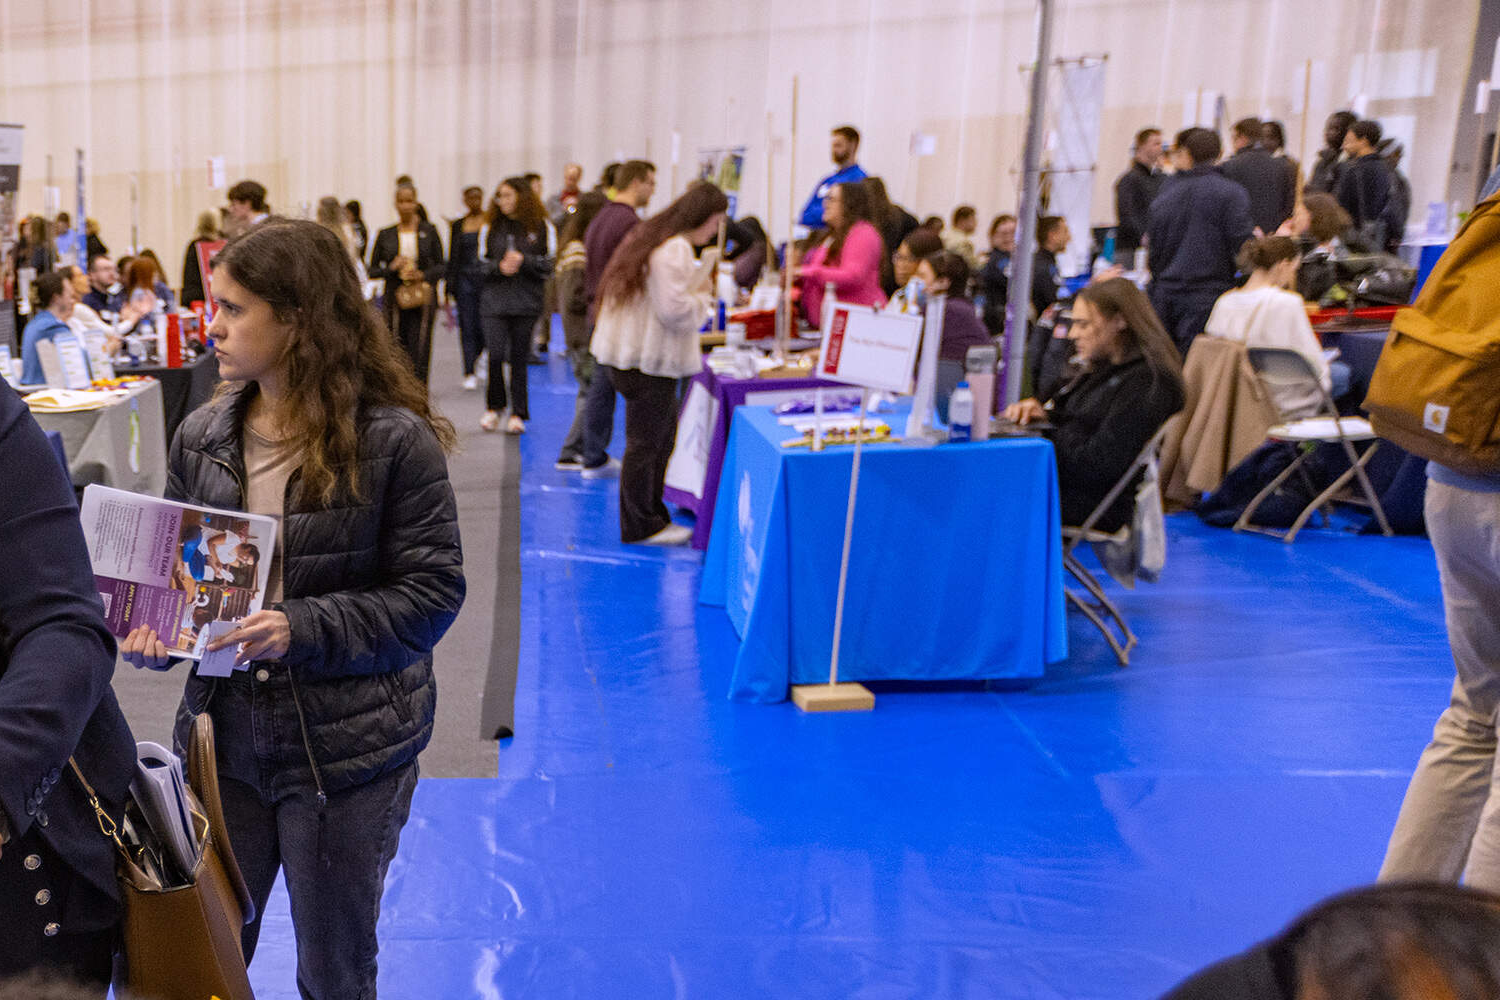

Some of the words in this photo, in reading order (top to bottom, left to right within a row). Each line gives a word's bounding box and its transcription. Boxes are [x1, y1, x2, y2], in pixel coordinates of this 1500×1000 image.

[167, 513, 178, 536] JOIN
[163, 536, 174, 554] OUR
[158, 555, 170, 577] TEAM
